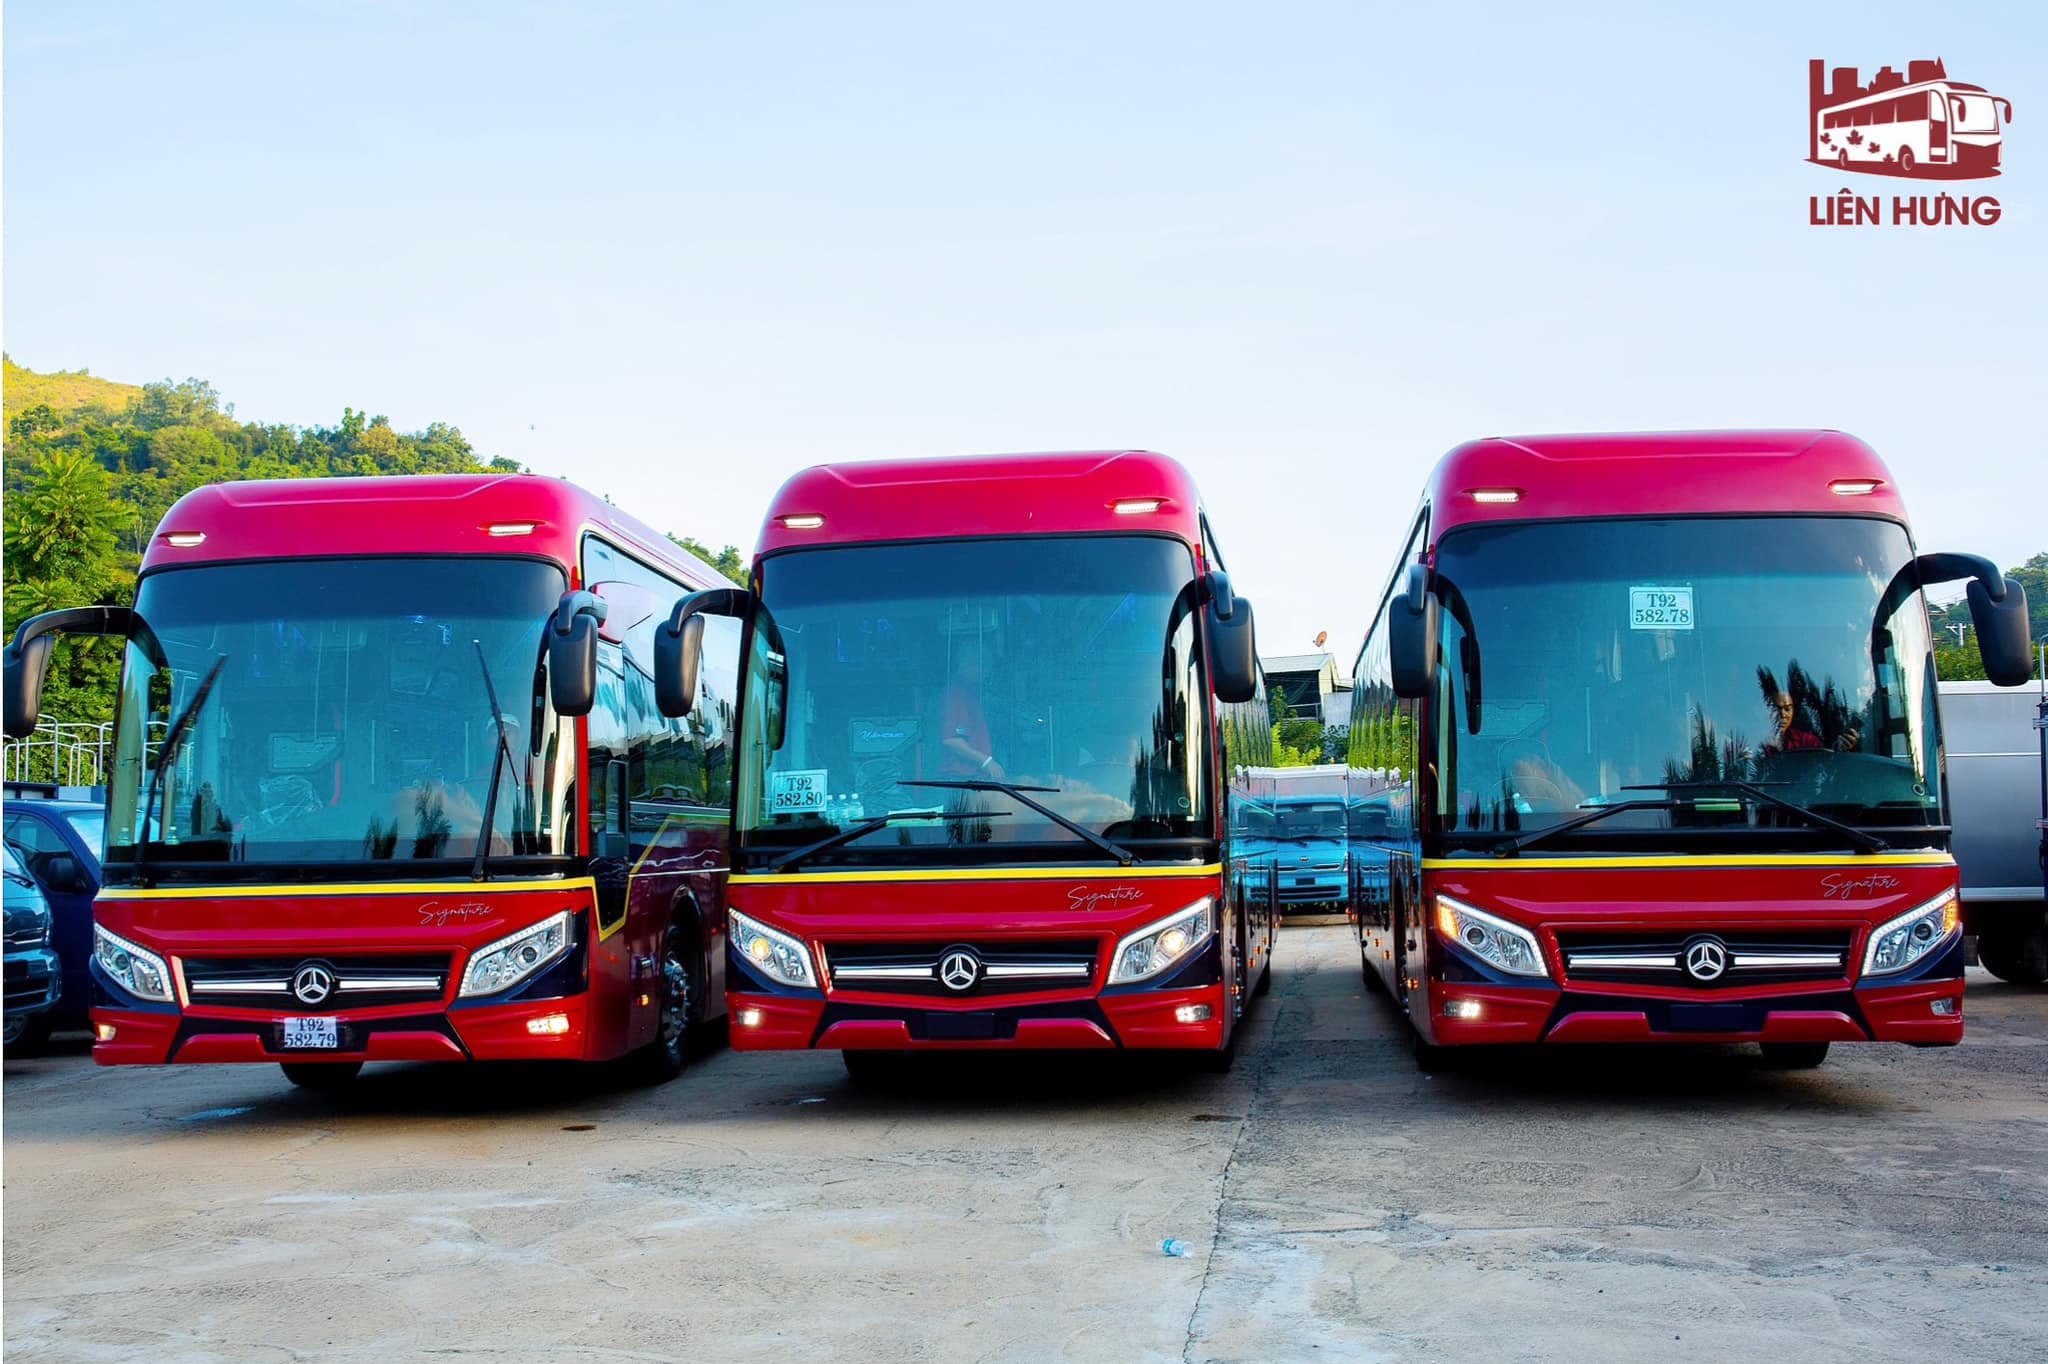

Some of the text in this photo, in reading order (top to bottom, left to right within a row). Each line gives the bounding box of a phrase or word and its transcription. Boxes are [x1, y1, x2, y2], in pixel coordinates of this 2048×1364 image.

[1646, 593, 1677, 608] T92
[1635, 608, 1690, 623] 582.78
[786, 776, 813, 791] T92
[775, 791, 823, 807] 582.80
[1820, 872, 1901, 900] Signature
[1067, 885, 1145, 912] Signature
[417, 900, 494, 927] Signature
[296, 1017, 325, 1031] T92
[284, 1032, 336, 1047] 582.79
